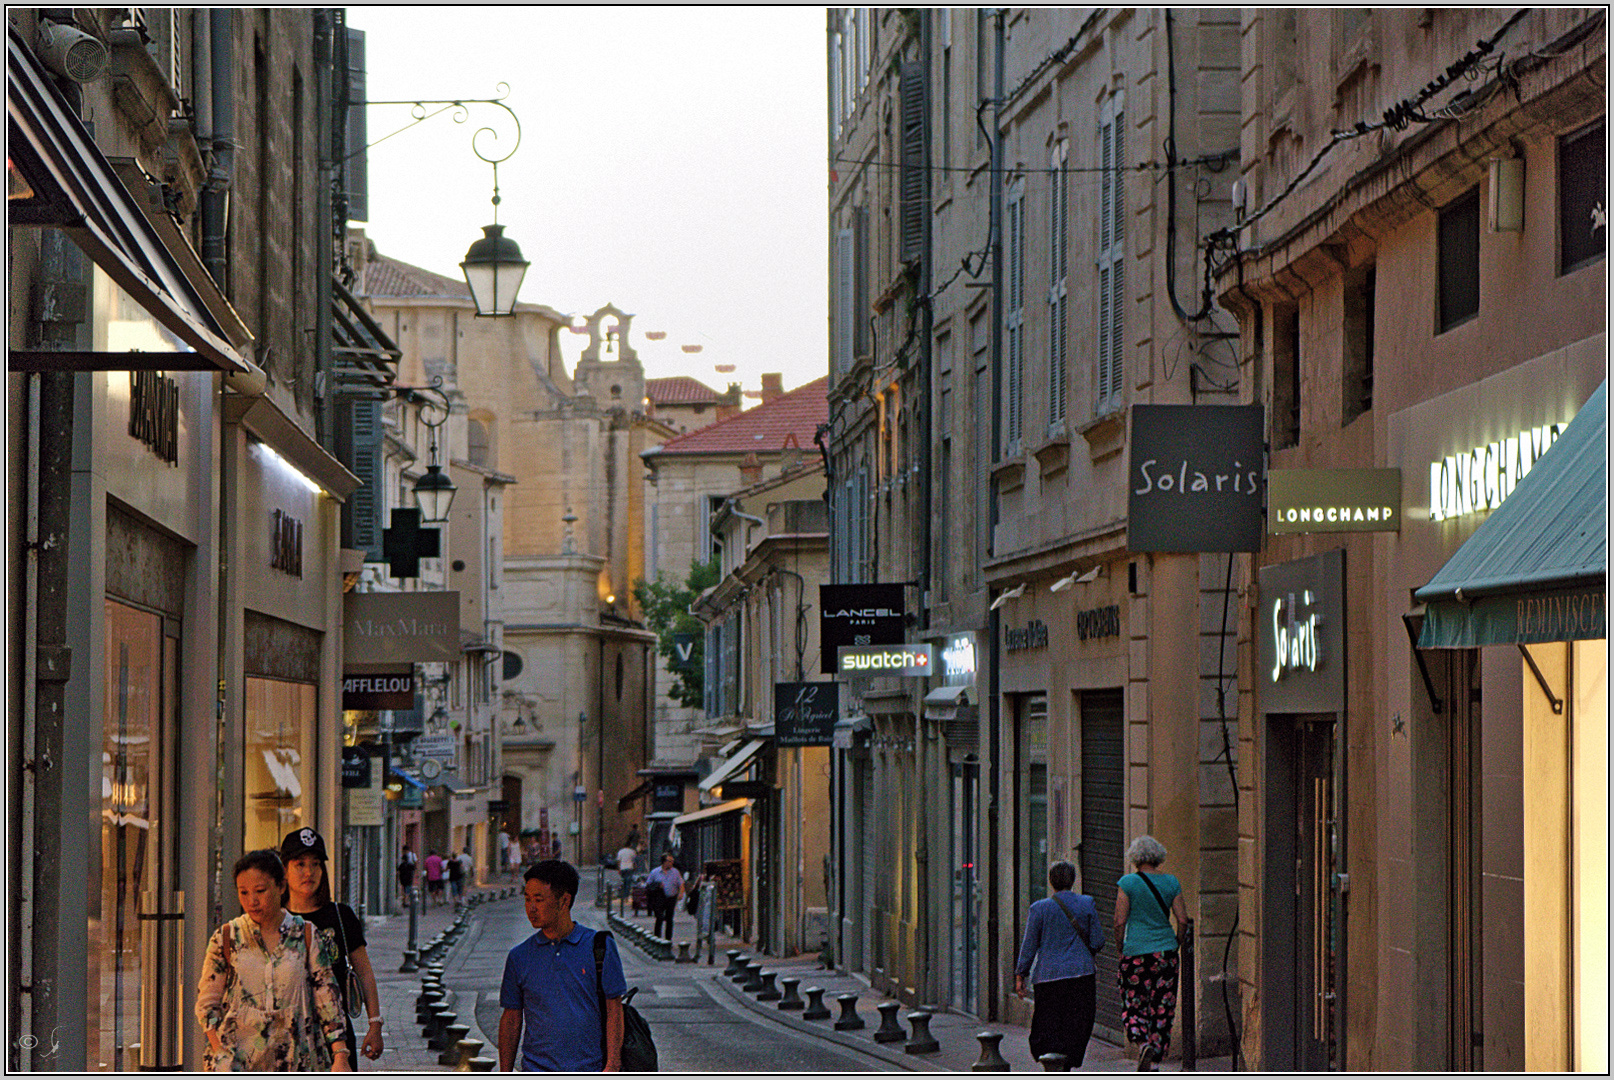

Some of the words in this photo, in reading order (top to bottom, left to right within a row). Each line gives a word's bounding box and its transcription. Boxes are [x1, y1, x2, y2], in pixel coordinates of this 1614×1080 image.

[1135, 459, 1257, 495] Solaris
[1277, 507, 1393, 523] LONGCHAMP
[824, 608, 901, 618] LANCEL
[354, 619, 447, 636] MaxMara
[1272, 589, 1321, 683] Solaris
[676, 642, 693, 661] V
[843, 651, 915, 670] swatch
[342, 678, 410, 693] AFFLELOU
[795, 686, 818, 703] 12
